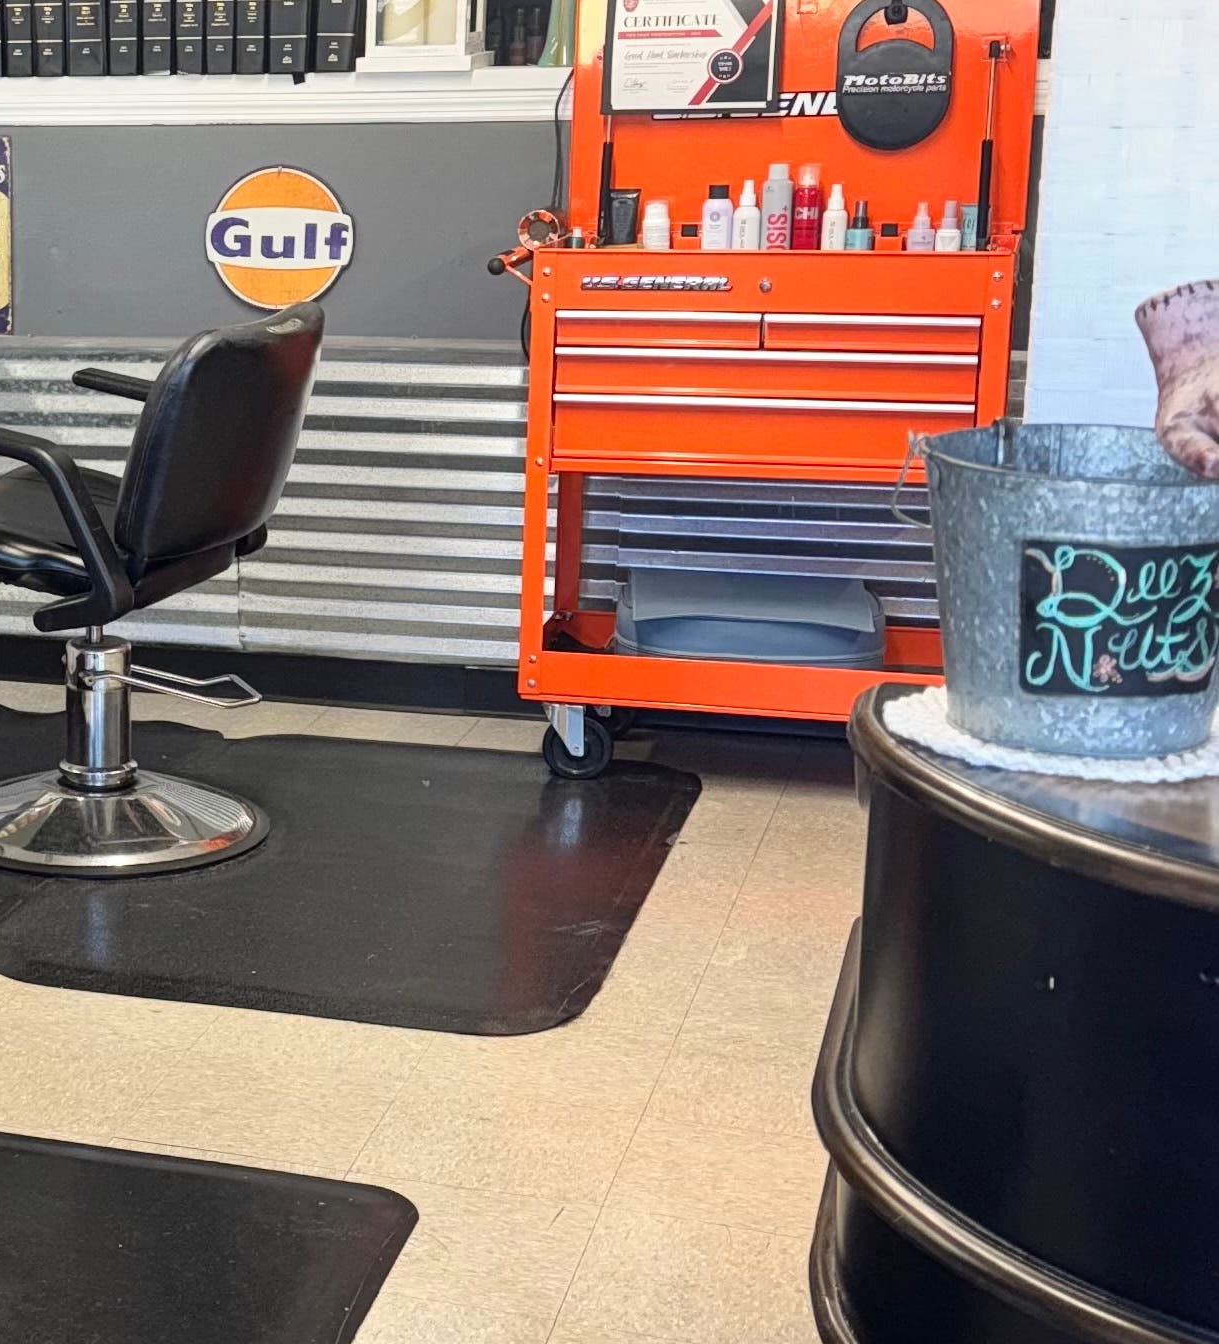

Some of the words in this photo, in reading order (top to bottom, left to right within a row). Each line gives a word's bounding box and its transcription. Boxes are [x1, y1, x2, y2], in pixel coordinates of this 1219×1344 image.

[623, 13, 720, 28] CERTIFICATE
[795, 206, 819, 220] CHI
[210, 217, 350, 260] Gulf
[1026, 616, 1214, 692] Nuts
